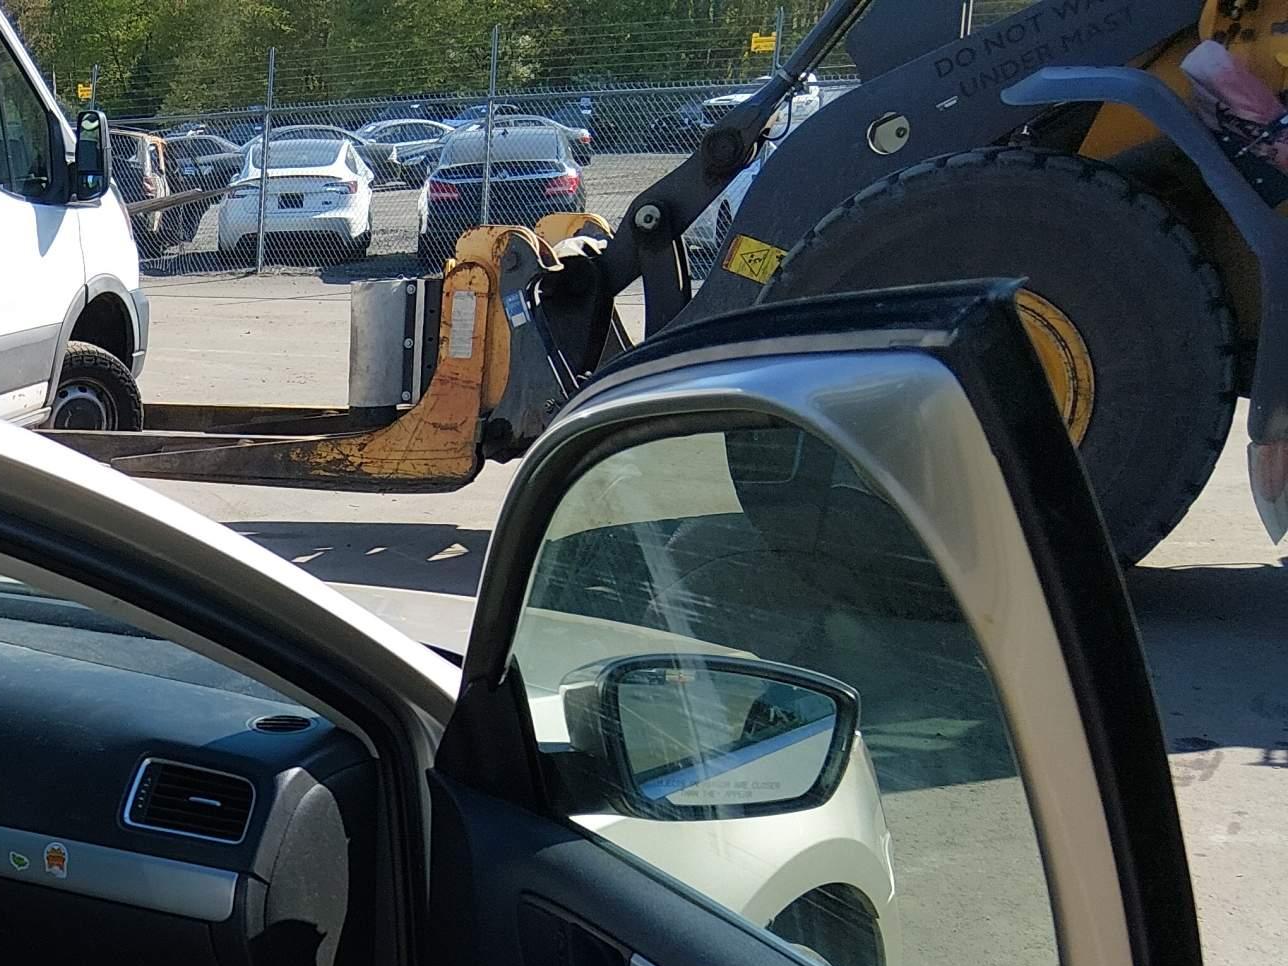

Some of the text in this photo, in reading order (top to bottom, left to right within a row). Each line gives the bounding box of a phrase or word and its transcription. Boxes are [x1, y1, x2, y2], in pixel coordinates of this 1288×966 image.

[933, 47, 976, 78] DO
[983, 11, 1044, 56] NOT
[959, 5, 1134, 98] UNDER MAST
